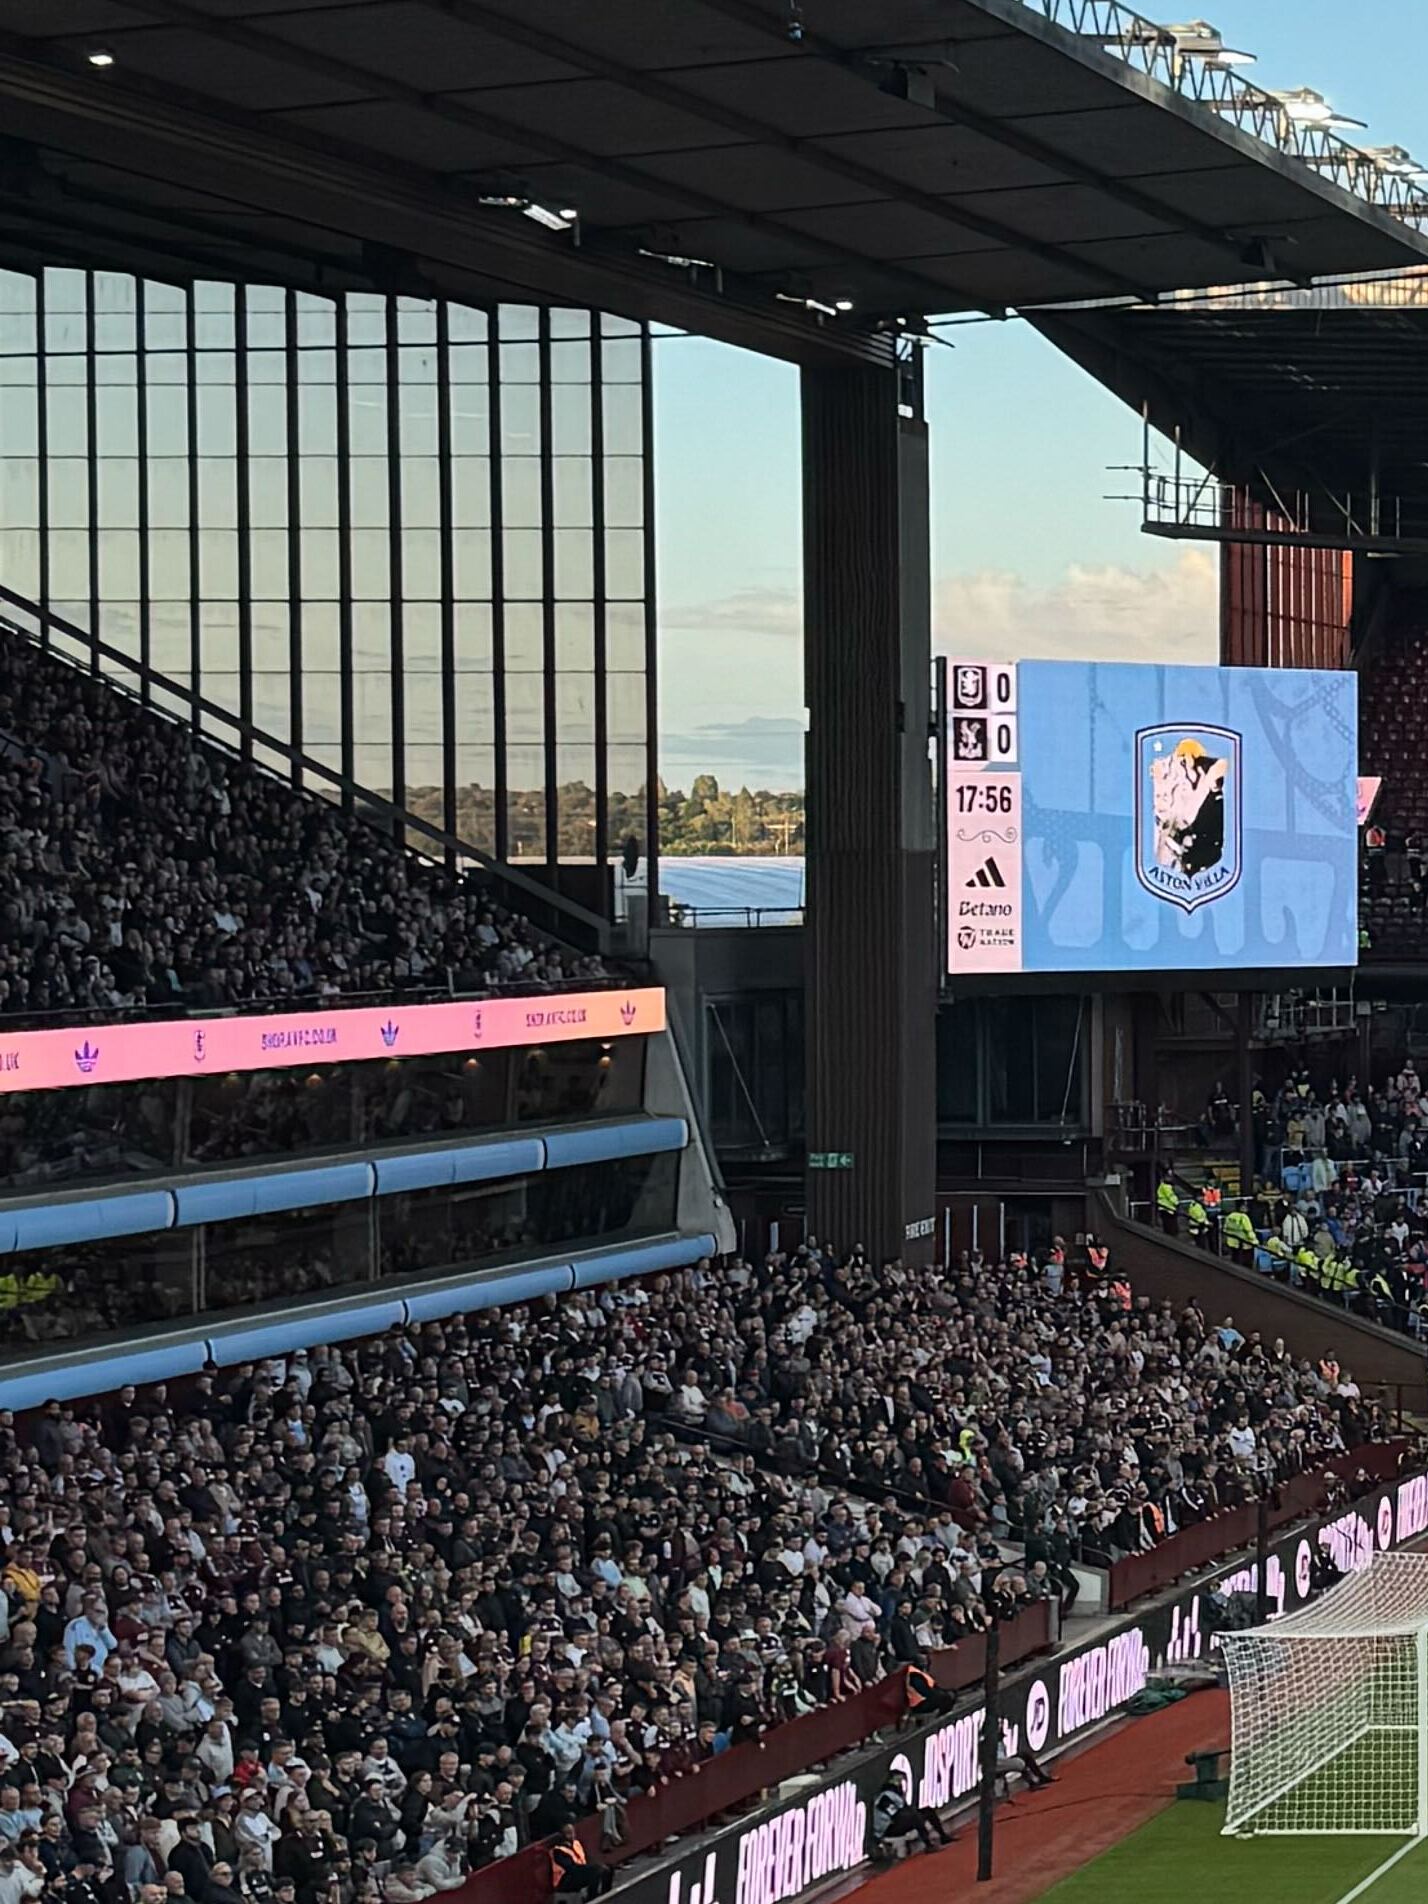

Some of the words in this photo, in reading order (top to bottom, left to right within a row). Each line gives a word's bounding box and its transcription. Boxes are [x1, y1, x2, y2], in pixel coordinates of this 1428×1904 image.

[996, 672, 1010, 703] 0
[997, 724, 1011, 754] 0
[956, 785, 1012, 813] 17:56
[1149, 866, 1192, 891] ASTON
[959, 900, 1012, 916] Betano
